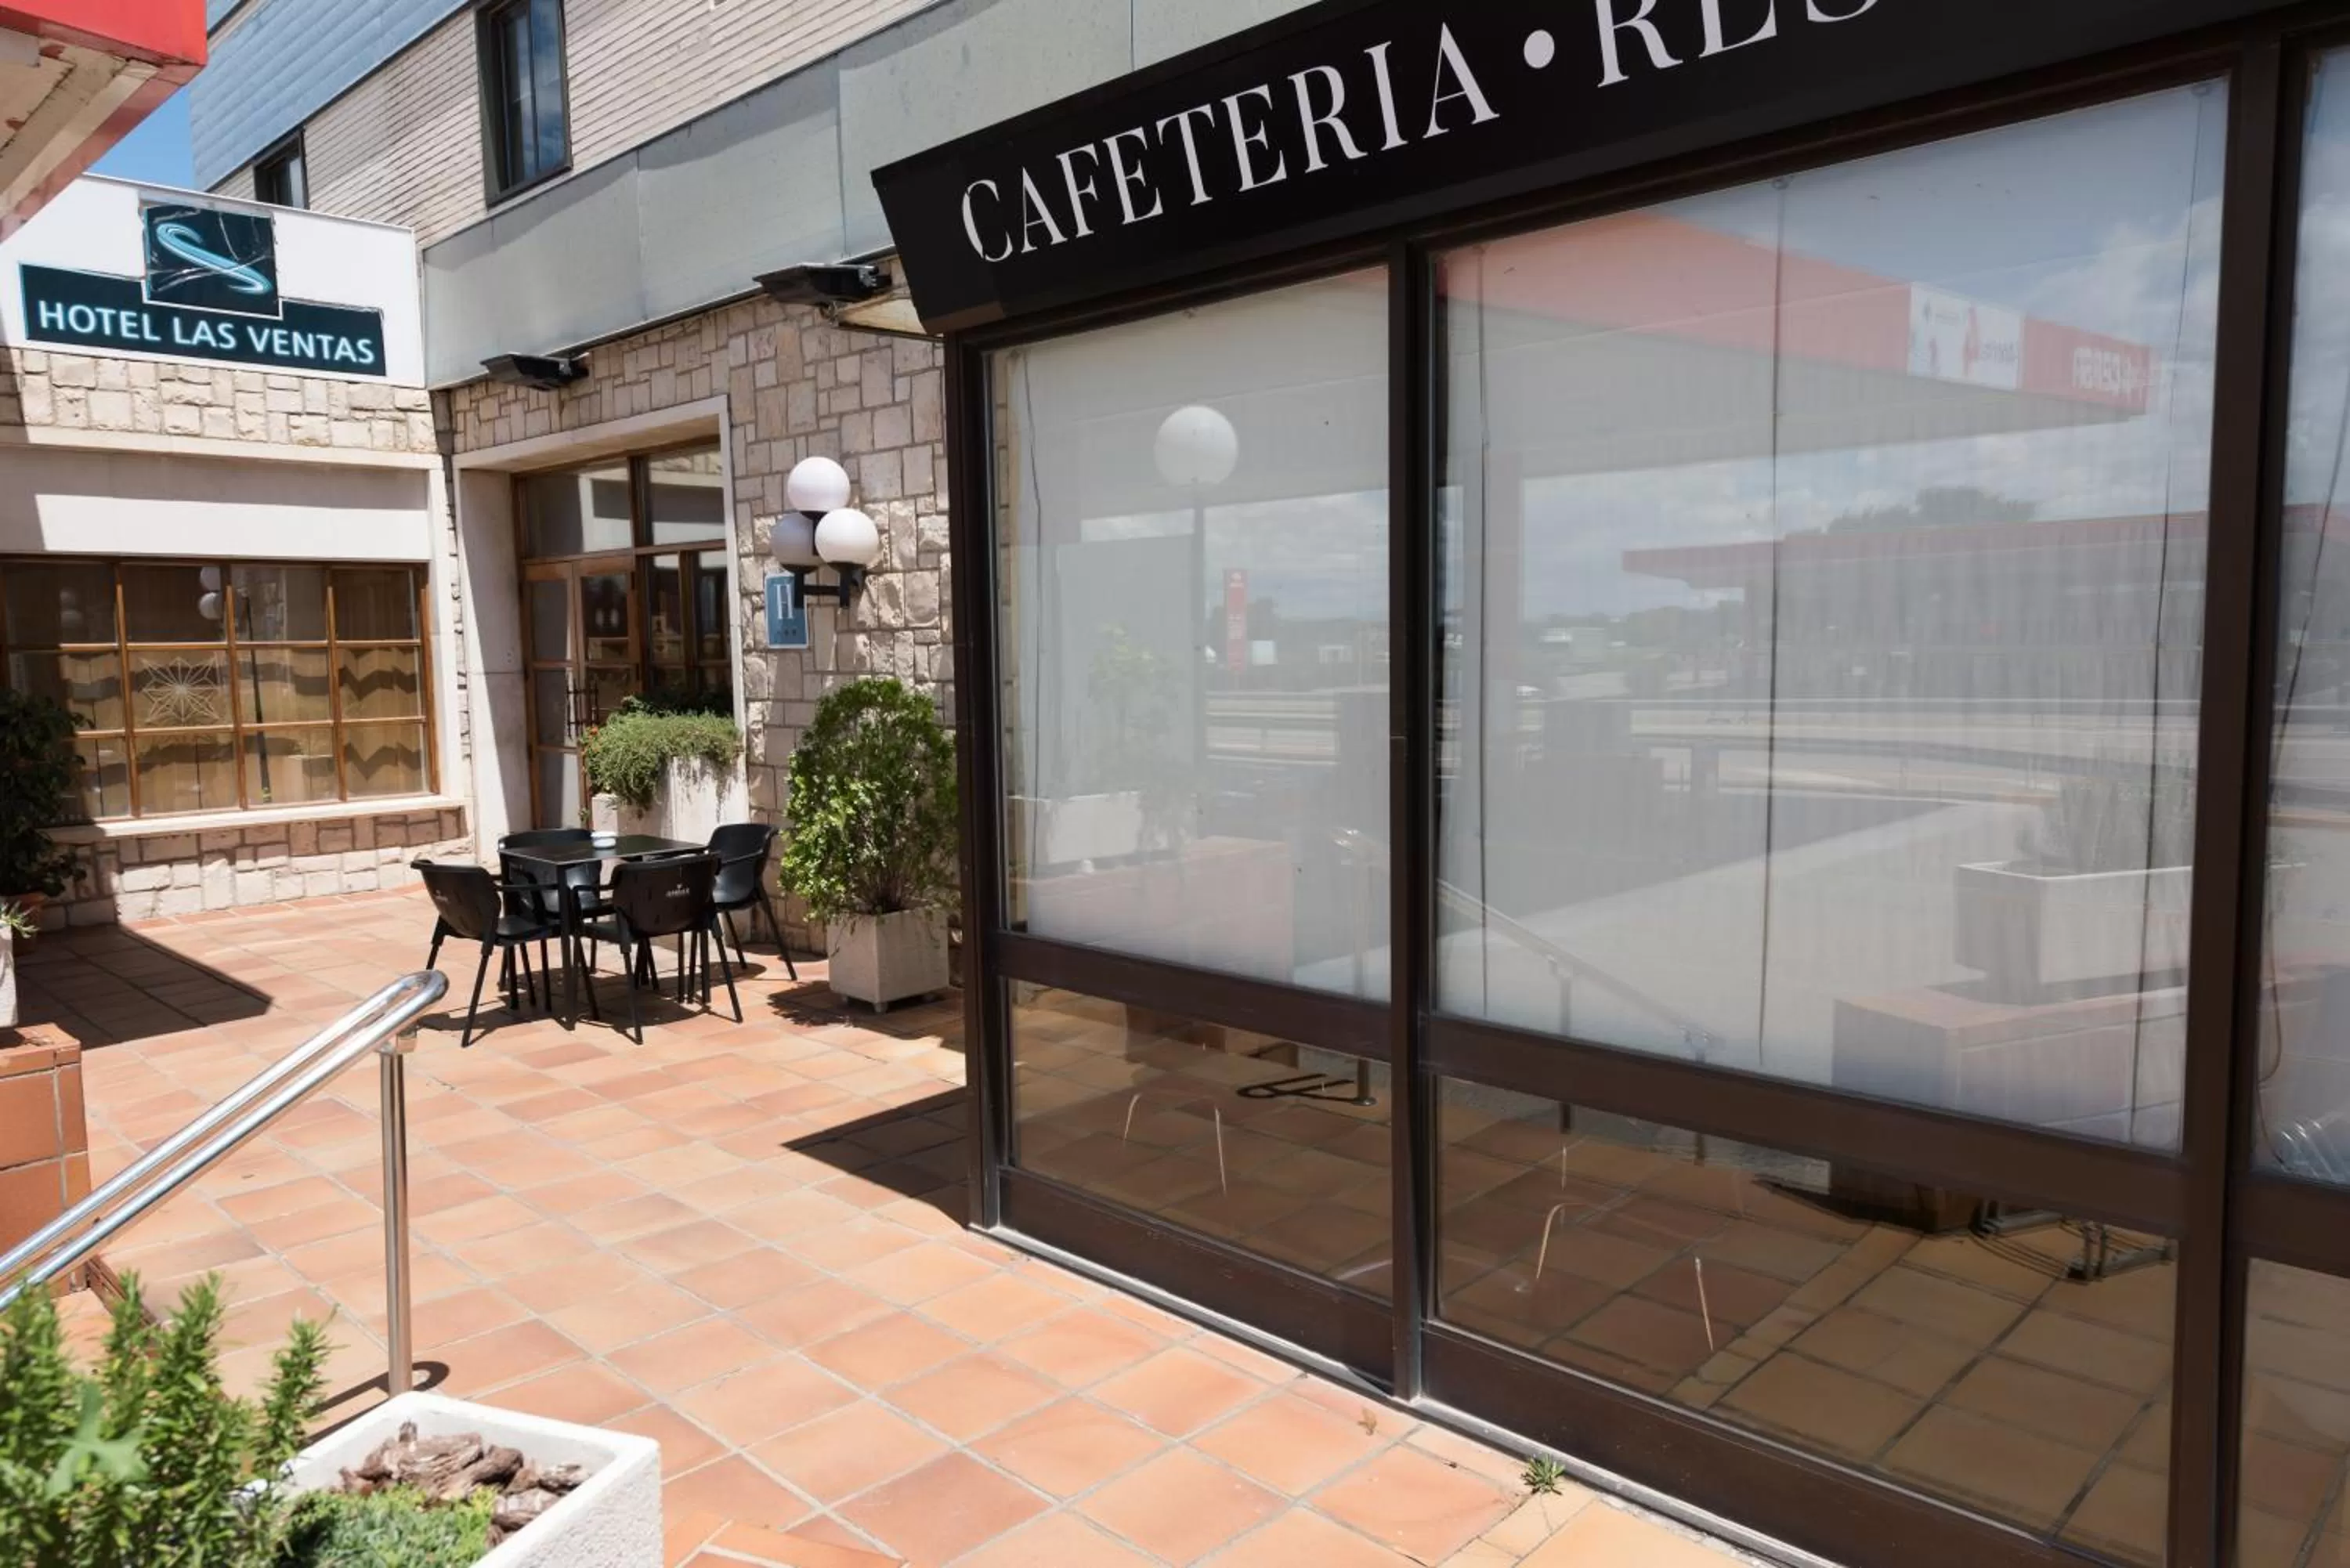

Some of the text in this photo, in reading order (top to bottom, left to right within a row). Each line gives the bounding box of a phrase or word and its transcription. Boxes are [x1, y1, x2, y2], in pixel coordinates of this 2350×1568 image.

[962, 21, 1500, 262] CAFETERIA
[38, 300, 375, 364] HOTEL LAS VENTAS
[773, 583, 794, 620] H
